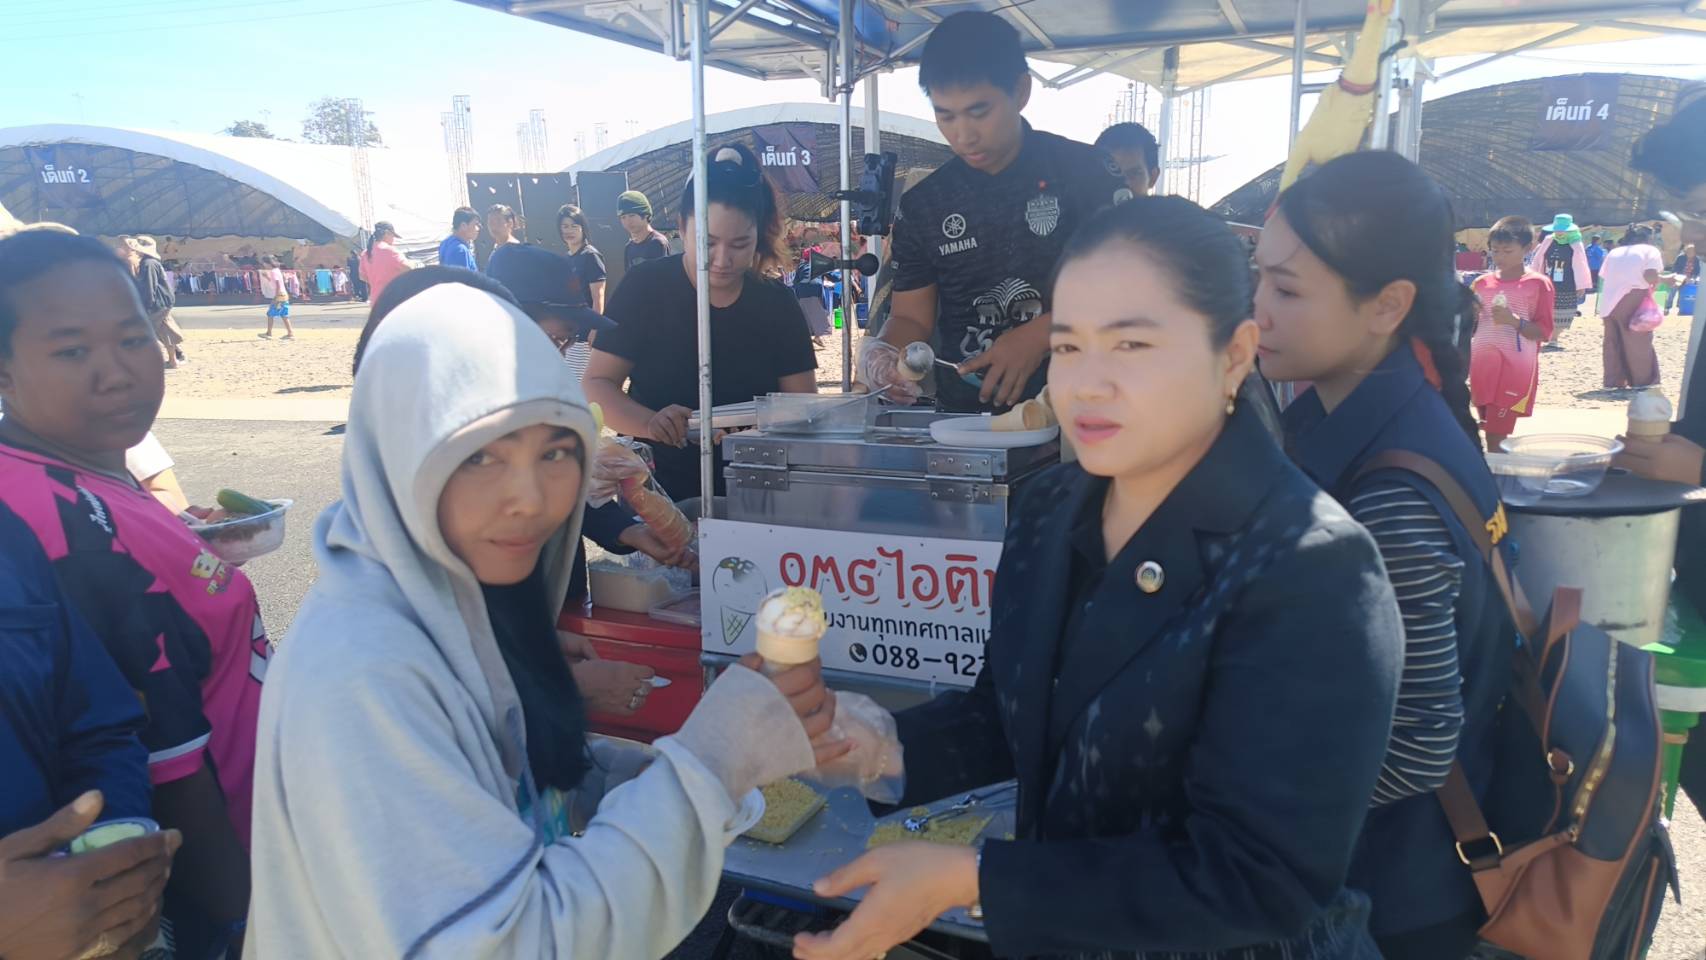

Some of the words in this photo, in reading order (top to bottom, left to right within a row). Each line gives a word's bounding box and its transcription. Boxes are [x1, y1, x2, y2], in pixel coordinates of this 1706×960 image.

[1545, 97, 1595, 121] เต็นท์
[1596, 103, 1609, 120] 4
[761, 145, 797, 166] เต็นท์
[801, 149, 811, 166] 3
[78, 168, 91, 183] 2
[938, 236, 978, 256] YAMAHA
